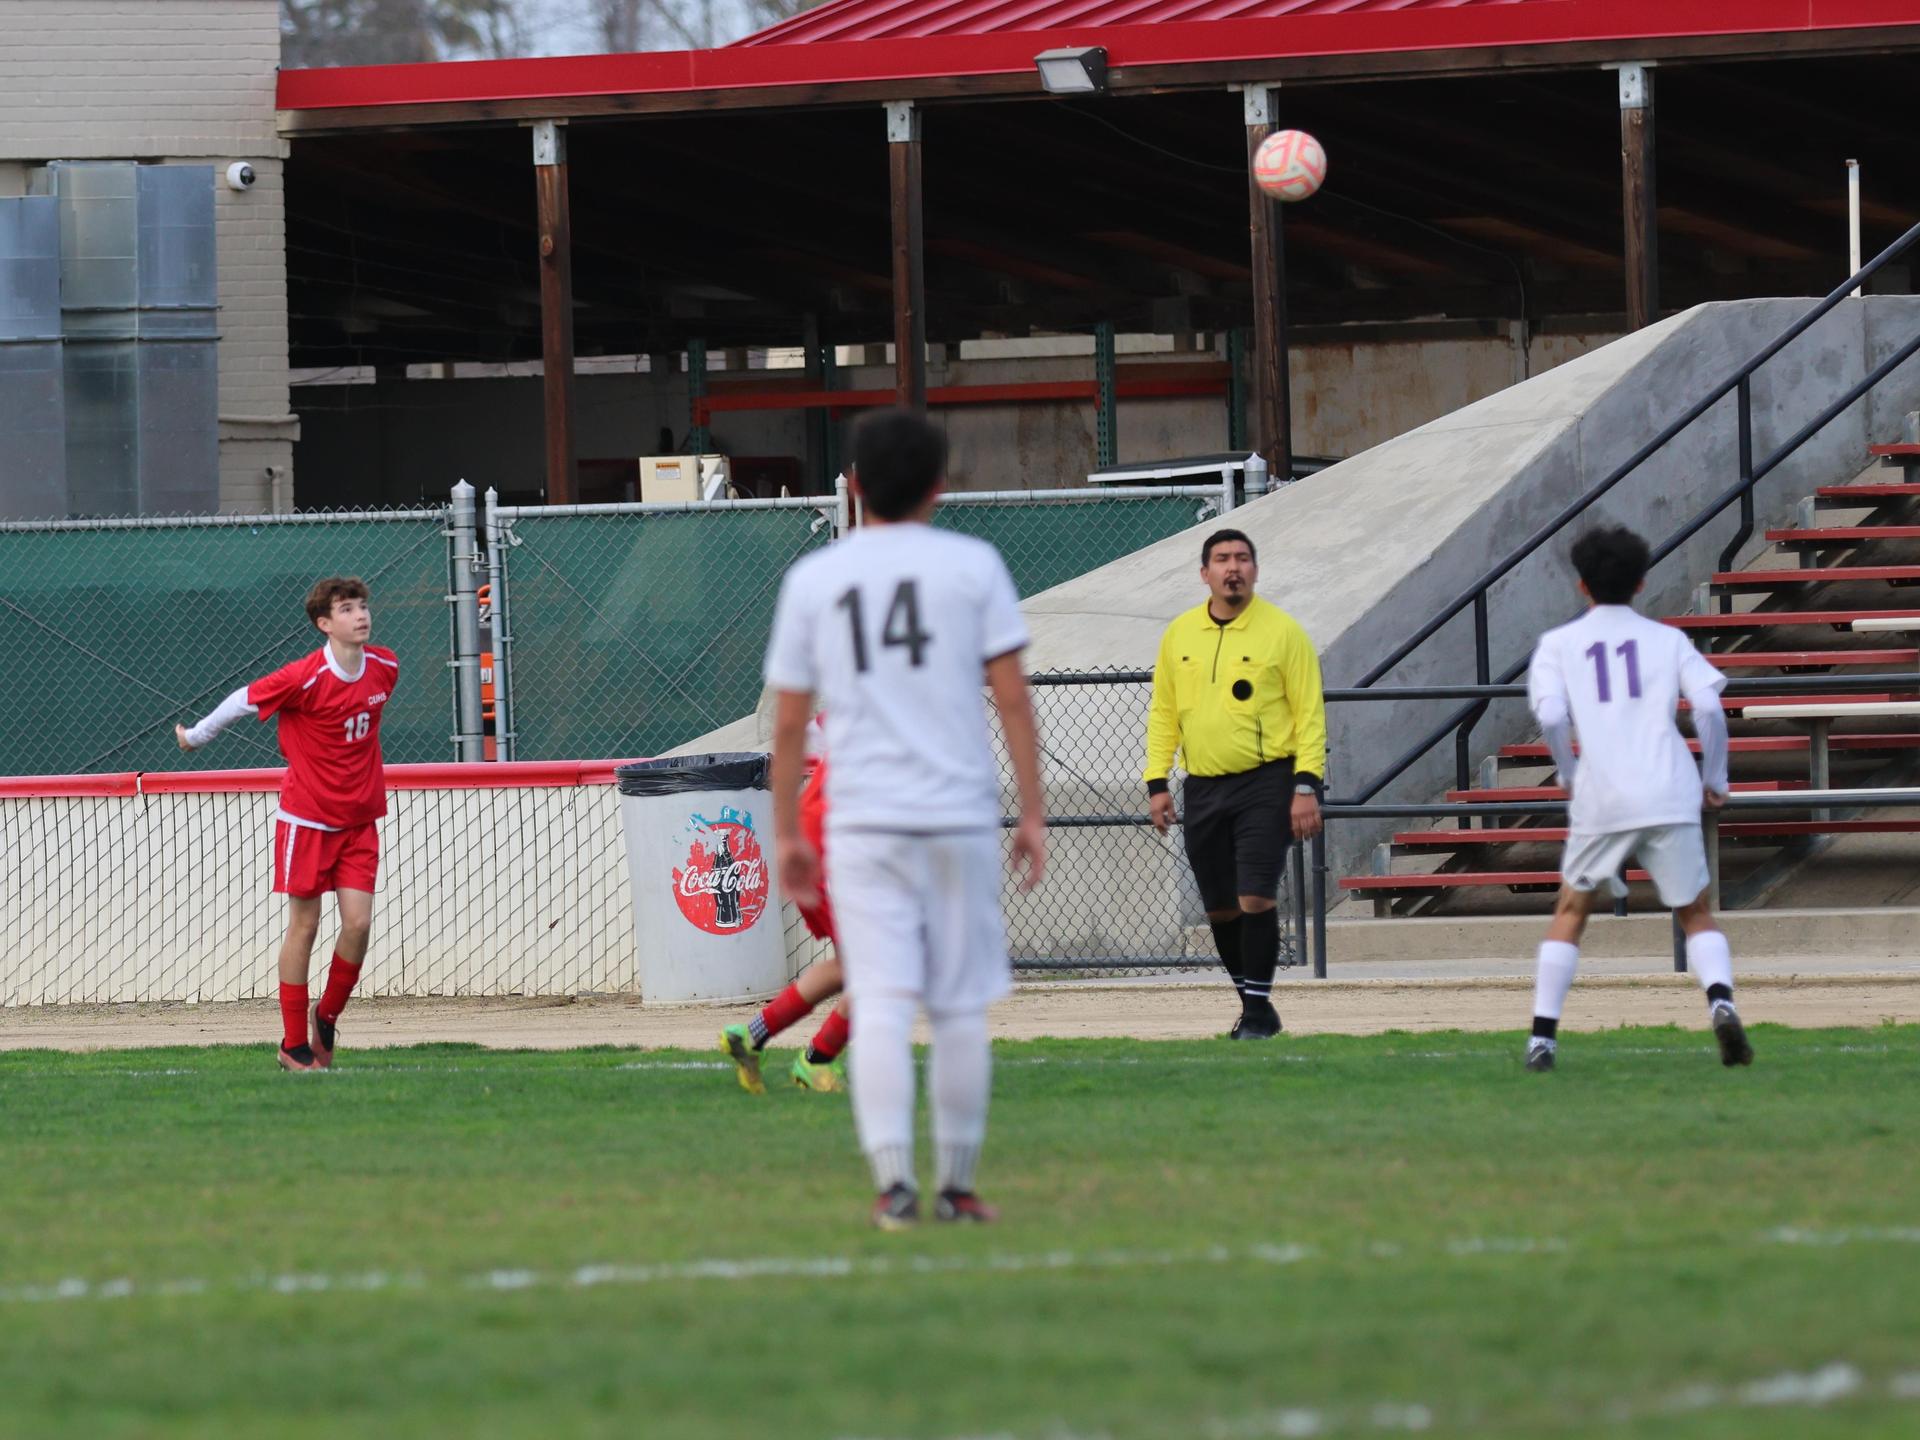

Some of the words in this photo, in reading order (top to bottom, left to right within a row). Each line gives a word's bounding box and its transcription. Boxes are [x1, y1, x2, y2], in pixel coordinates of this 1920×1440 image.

[837, 579, 932, 671] 14
[1585, 639, 1642, 703] 11
[344, 711, 370, 743] 16
[680, 858, 761, 897] Coca-Cola
